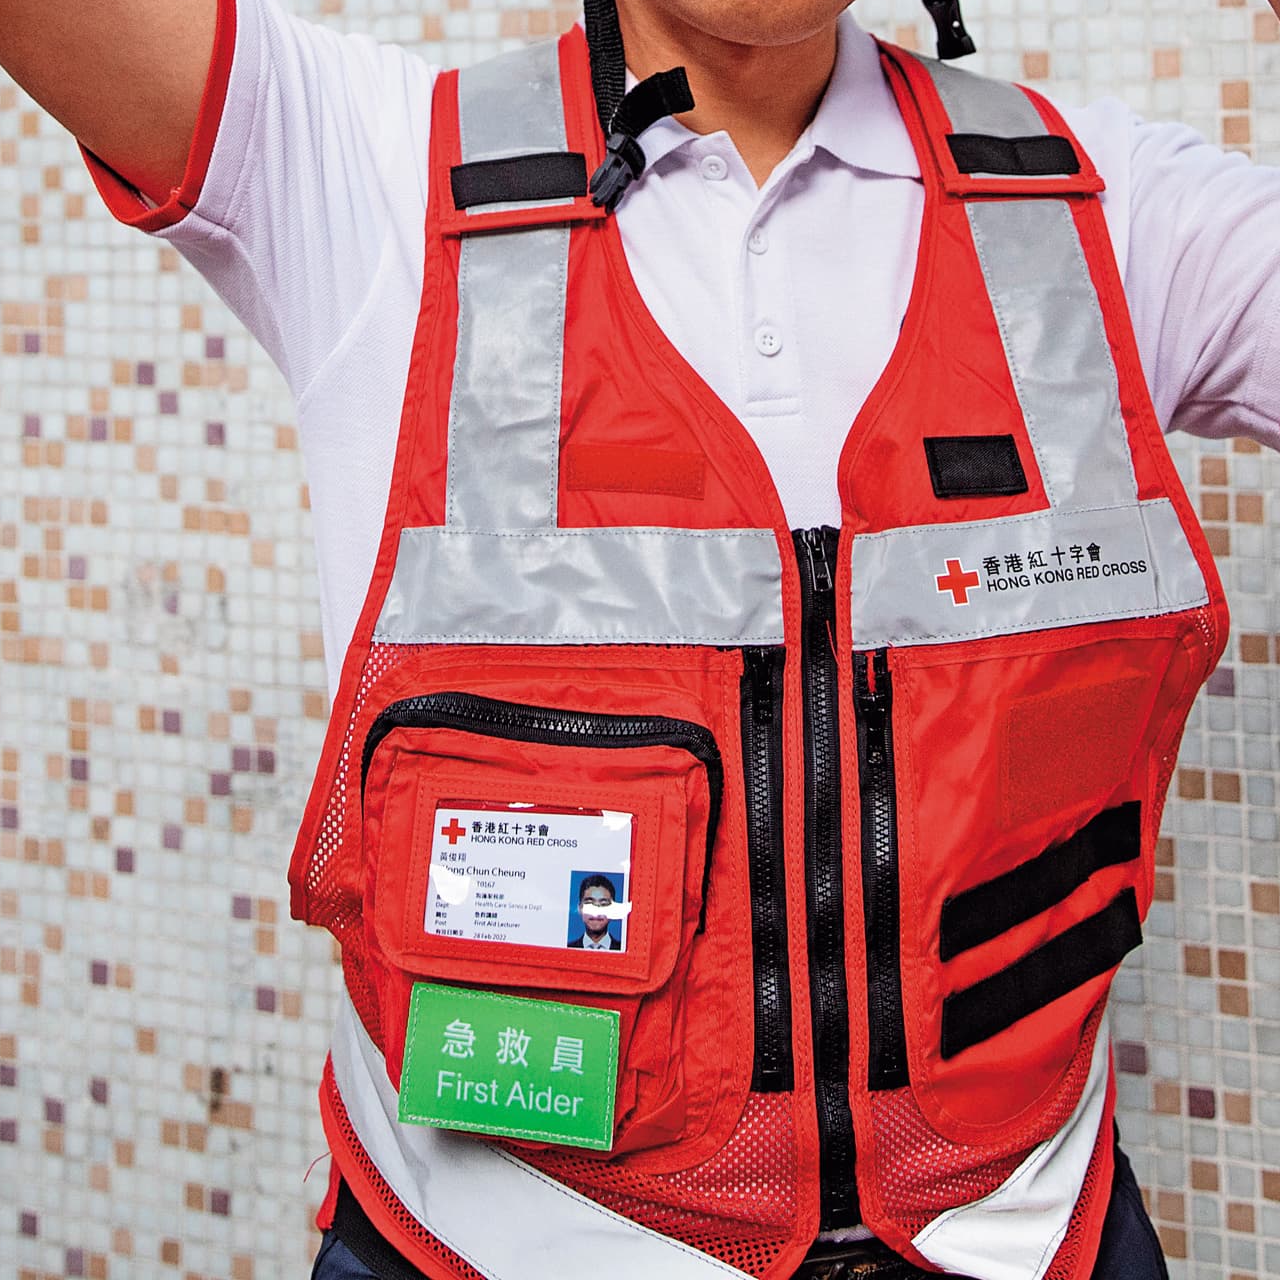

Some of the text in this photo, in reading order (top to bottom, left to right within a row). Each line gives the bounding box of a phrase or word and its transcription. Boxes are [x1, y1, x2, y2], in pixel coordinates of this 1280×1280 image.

[983, 542, 1102, 577] 香港紅十字會
[987, 559, 1147, 593] HONG KONG RED CROSS
[471, 835, 578, 848] HONG KONG RED CROSS
[472, 821, 549, 837] 香港紅十字會
[442, 865, 526, 879] ong Chun Cheung
[441, 1018, 584, 1075] 急救員
[436, 1070, 584, 1117] First Aider
